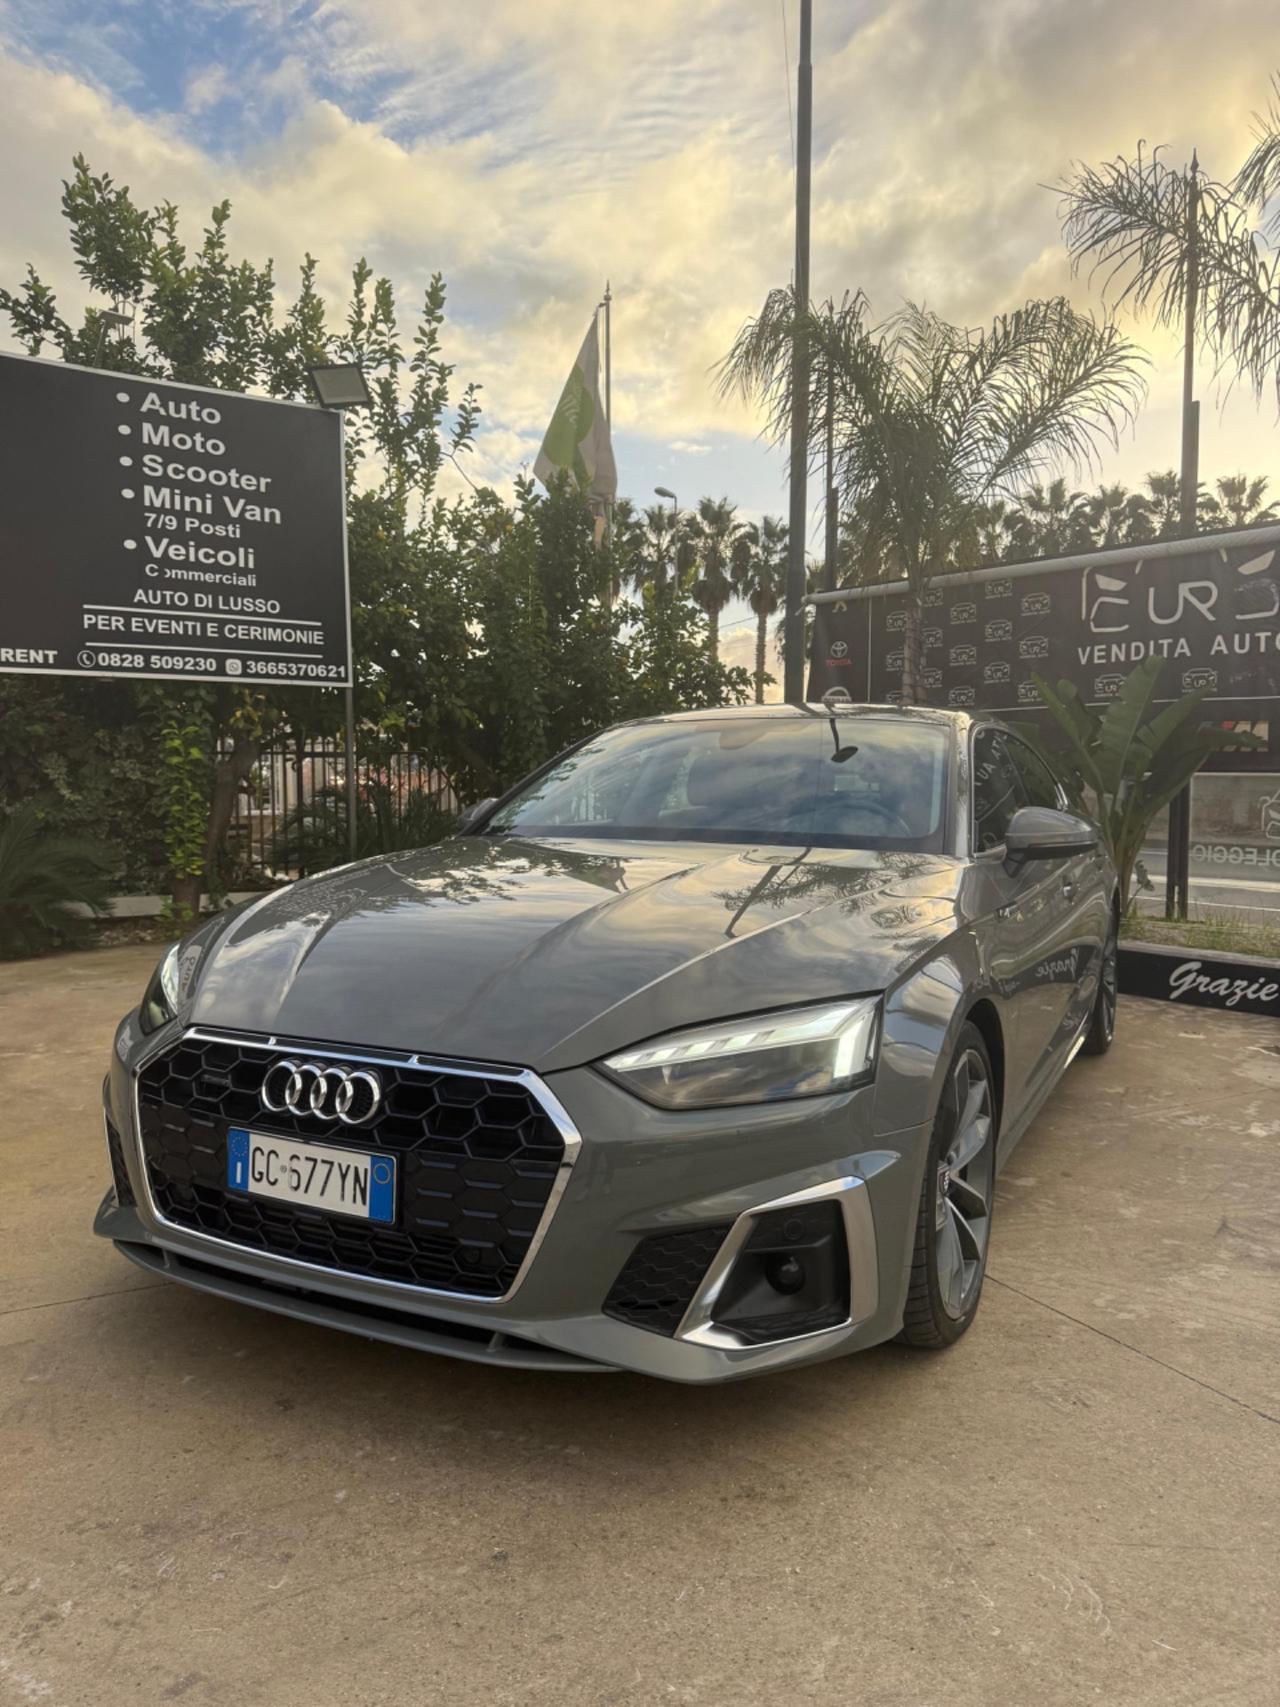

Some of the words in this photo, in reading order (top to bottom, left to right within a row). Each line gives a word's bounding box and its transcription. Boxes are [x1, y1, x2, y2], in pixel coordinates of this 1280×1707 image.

[140, 391, 222, 424] Auto
[142, 422, 226, 455] Moto
[142, 454, 272, 493] Scooter
[144, 485, 213, 514] Mini
[223, 496, 282, 524] Van
[144, 513, 178, 530] 7/9
[185, 517, 241, 538] Posti
[144, 535, 255, 569] Veicoli
[133, 589, 189, 606] AUTO
[194, 593, 213, 608] DI
[218, 595, 281, 614] LUSSO
[83, 614, 126, 631] PER
[131, 617, 202, 637] EVENTI
[207, 622, 219, 637] E
[224, 624, 325, 645] CERIMONIE
[0, 647, 59, 664] RENT
[1078, 637, 1192, 665] VENDITA
[1210, 631, 1280, 656] AUT
[98, 652, 145, 668] 0828
[150, 655, 217, 672] 509230
[246, 660, 346, 678] 3665370621
[1169, 961, 1279, 1006] Grazie
[251, 1146, 280, 1186] GC
[287, 1154, 368, 1206] 677YN
